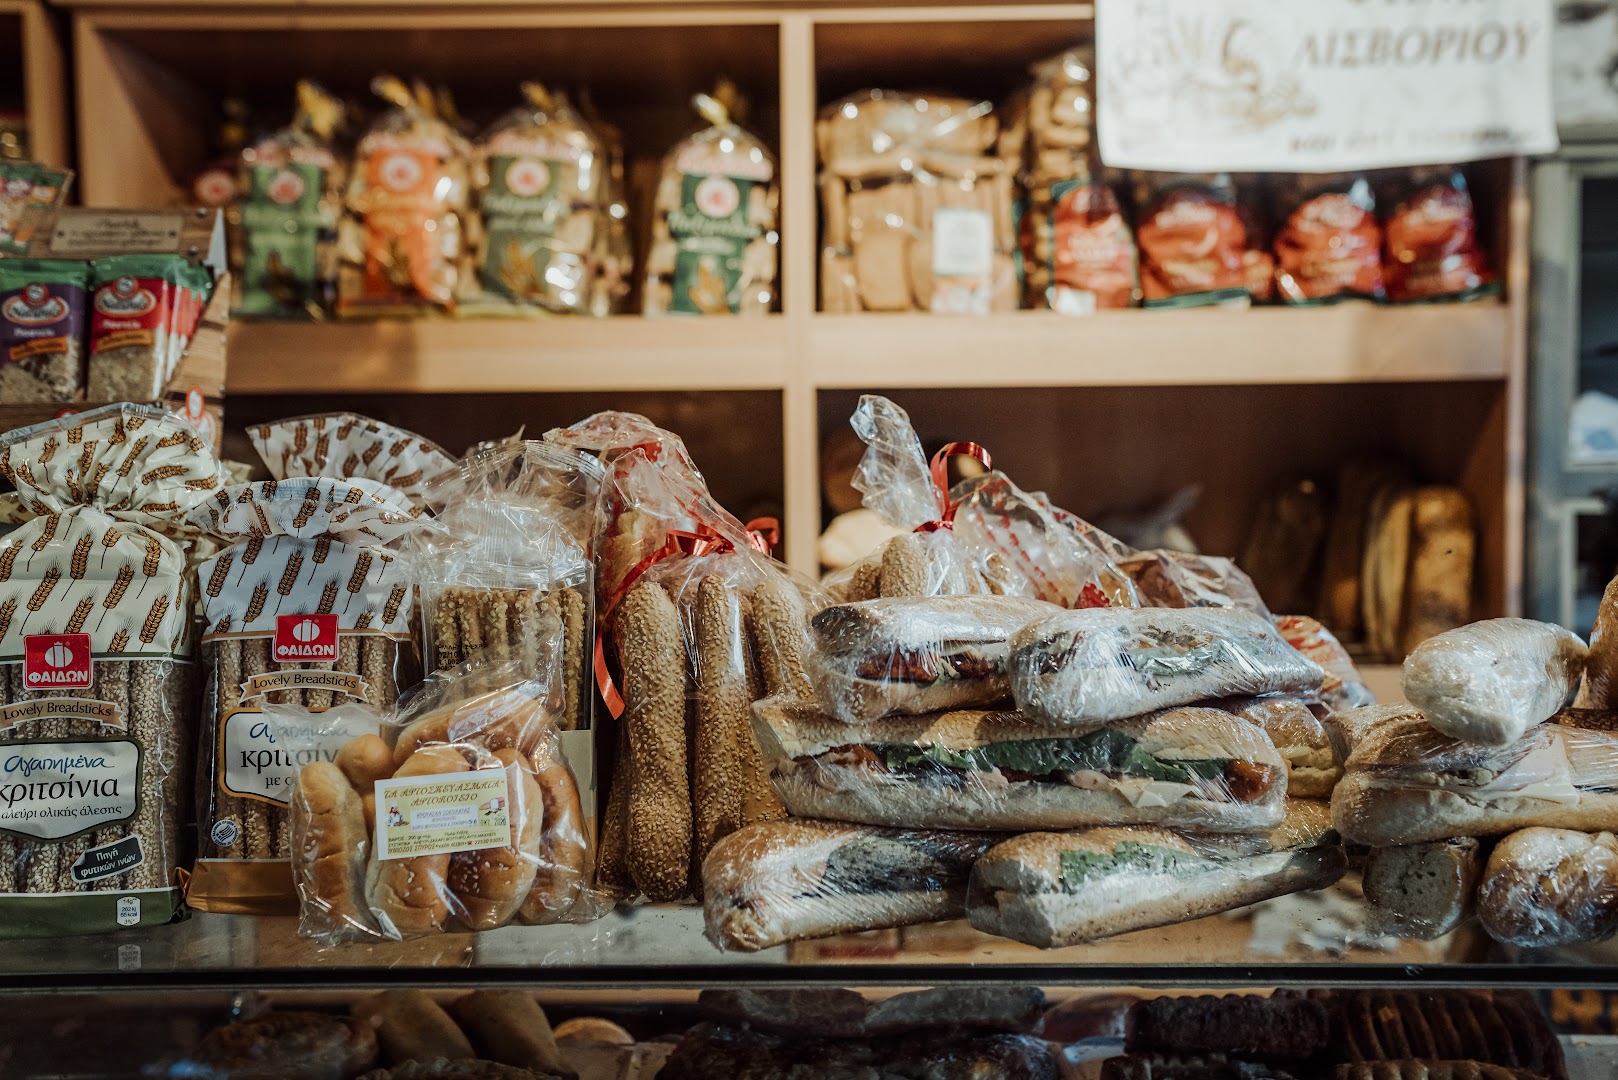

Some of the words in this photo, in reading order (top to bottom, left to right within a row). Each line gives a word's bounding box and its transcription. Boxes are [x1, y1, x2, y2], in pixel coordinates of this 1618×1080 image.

[277, 644, 335, 656] ΦΑΙΔΩΝ
[28, 670, 88, 683] ΦΑΙΔΩΝ
[253, 674, 291, 689] Lovely
[294, 673, 357, 688] Breadsticks
[3, 703, 44, 720] Lovely
[47, 701, 112, 717] Breadsticks
[265, 776, 281, 789] με
[40, 806, 78, 818] ολικής
[80, 805, 122, 816] άλεσης
[96, 847, 118, 861] Πηγή
[81, 861, 115, 878] φυτικών
[117, 854, 136, 867] ινών
